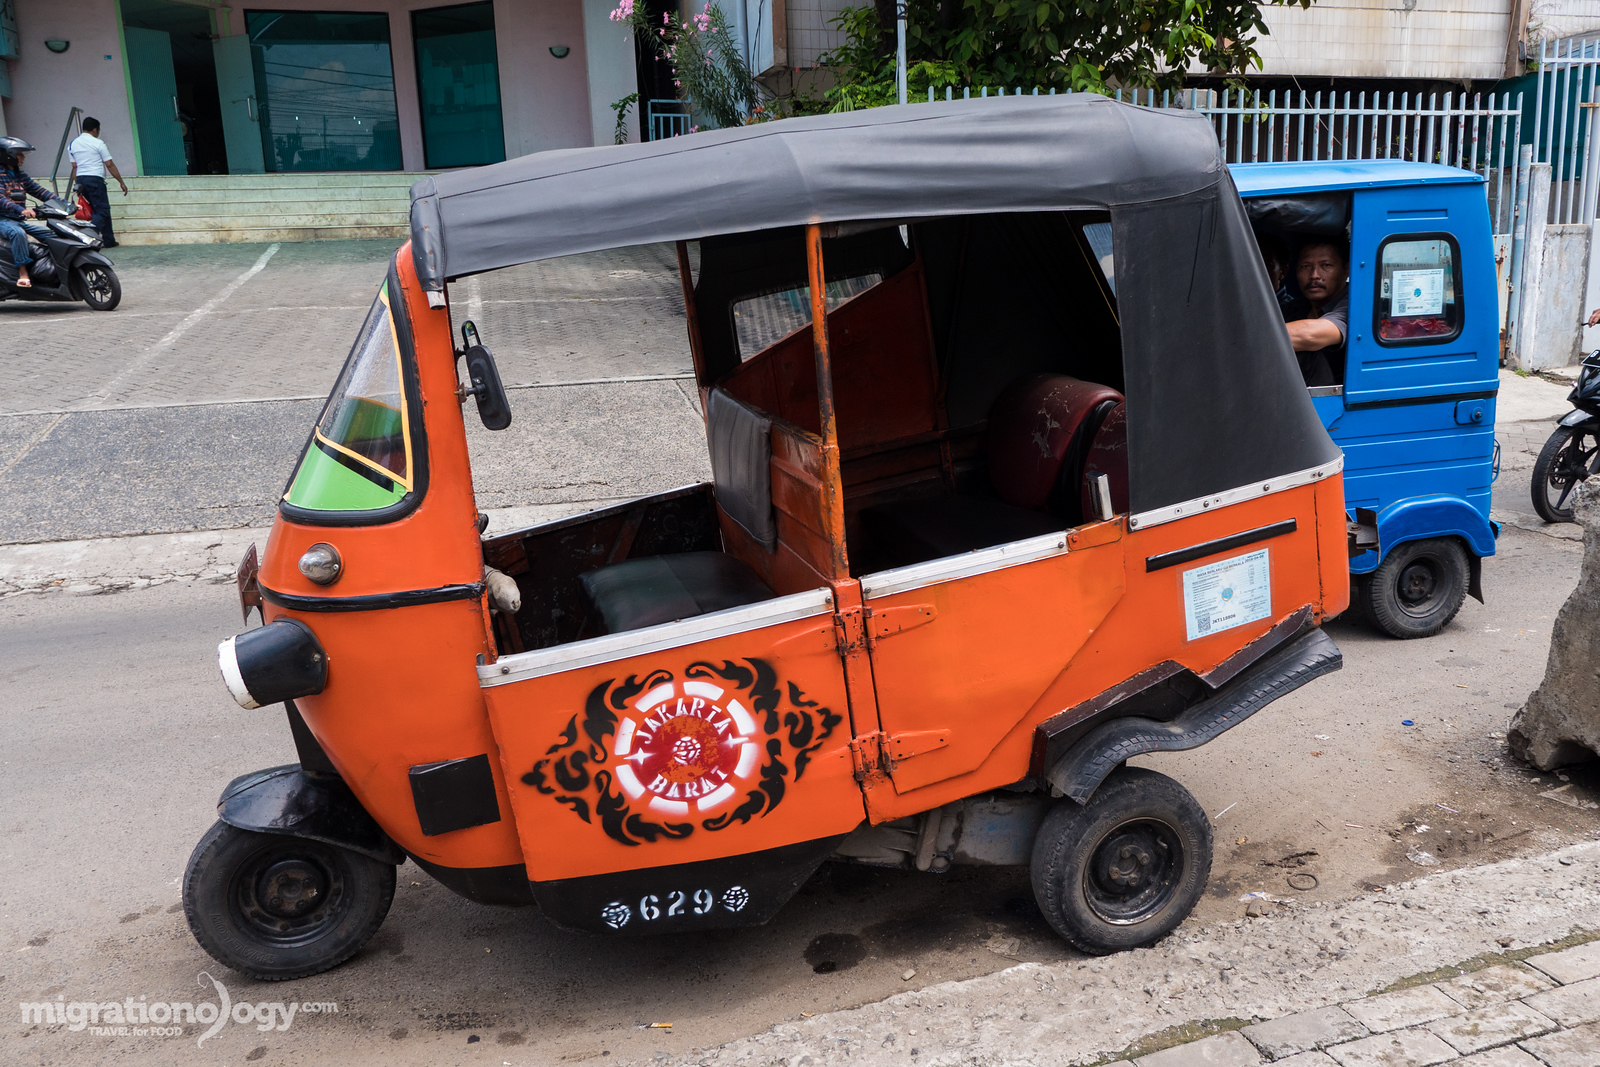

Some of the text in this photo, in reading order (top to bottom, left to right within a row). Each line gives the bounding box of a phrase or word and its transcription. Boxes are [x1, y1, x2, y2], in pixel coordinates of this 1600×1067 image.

[1229, 561, 1245, 569] BERKALA
[636, 697, 733, 745] JAKARTA
[647, 765, 728, 798] BARAT
[640, 889, 714, 921] 629
[210, 912, 279, 965] SWALLOW
